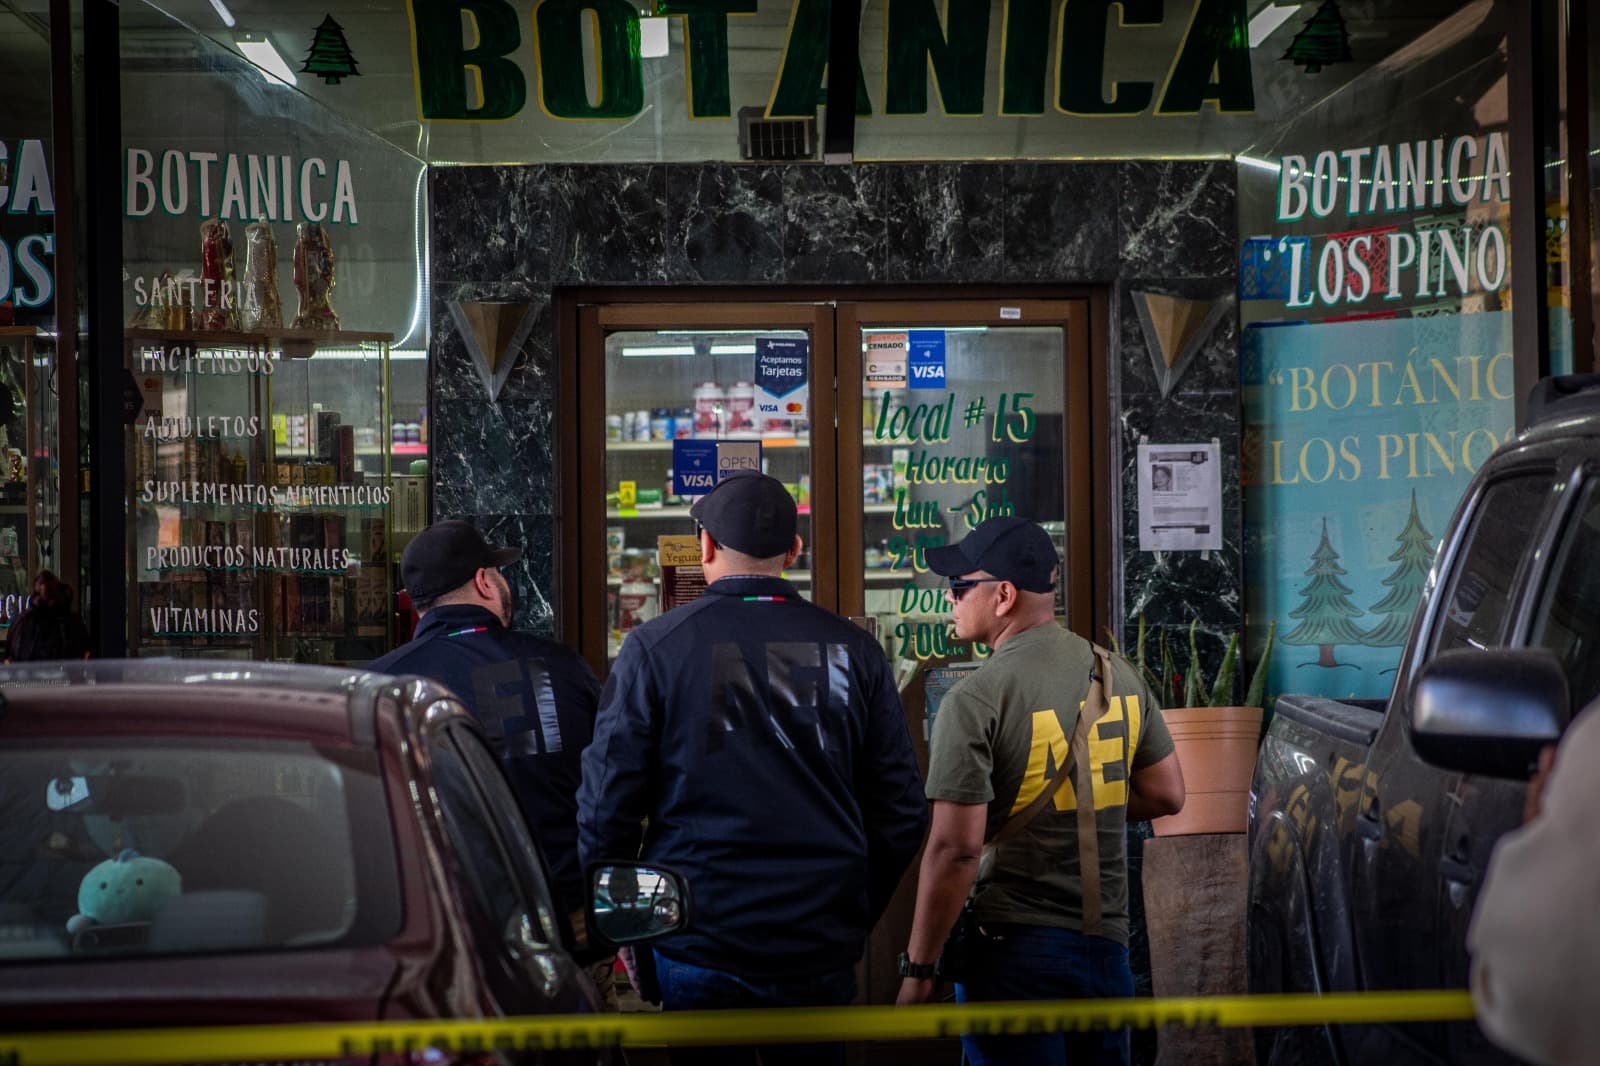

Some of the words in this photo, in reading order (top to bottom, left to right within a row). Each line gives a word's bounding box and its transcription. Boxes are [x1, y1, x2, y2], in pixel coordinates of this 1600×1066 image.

[412, 0, 1256, 121] BOTANICA
[126, 149, 358, 224] BOTANICA
[1277, 132, 1511, 222] BOTANICA
[135, 275, 258, 309] SANTERIA
[868, 342, 904, 350] CENSADO
[141, 346, 275, 374] INCIENSOS
[760, 356, 803, 366] Aceptamos
[760, 364, 803, 378] Tarjetas
[911, 366, 945, 378] VISA
[759, 404, 778, 413] VISA
[720, 456, 759, 469] OPEN
[904, 450, 1011, 485] Horario
[1271, 435, 1361, 484] LOS
[142, 480, 278, 506] SUPLEMENTOS
[681, 475, 714, 488] VISA
[147, 546, 245, 568] PRODUCTOS
[253, 547, 349, 570] NATURALES
[151, 606, 258, 634] VITAMINAS
[1008, 694, 1141, 817] AEI
